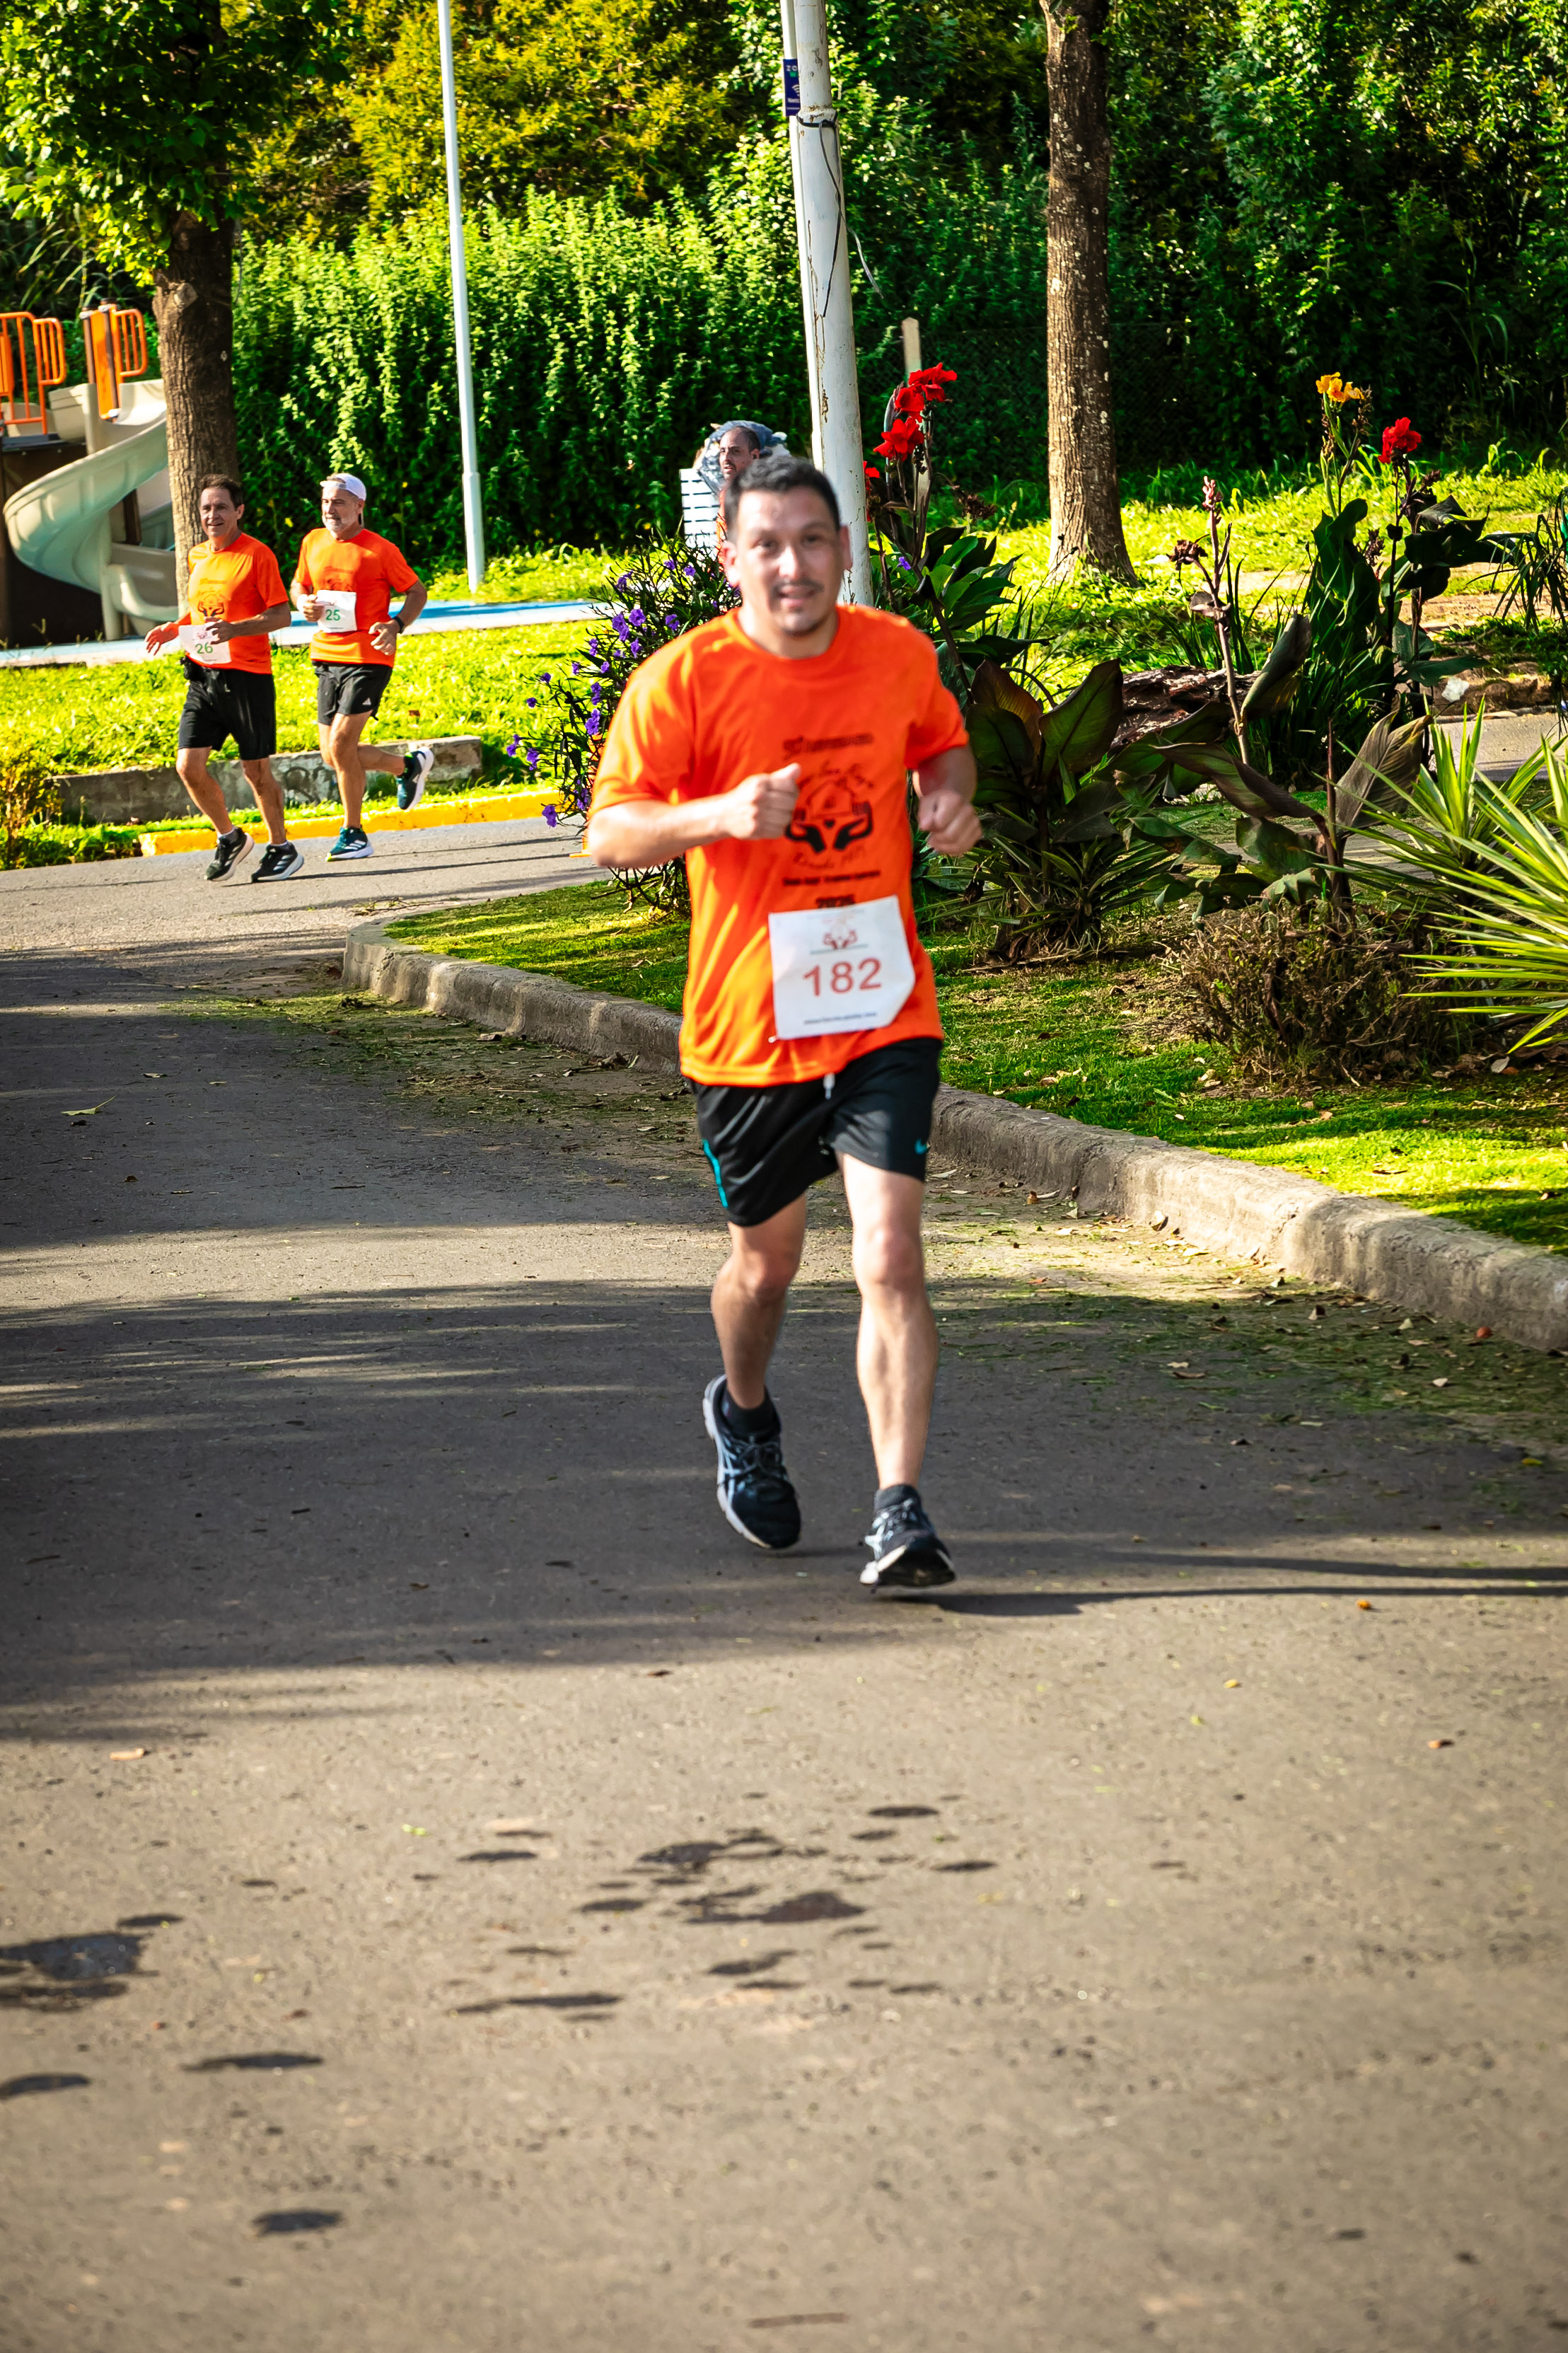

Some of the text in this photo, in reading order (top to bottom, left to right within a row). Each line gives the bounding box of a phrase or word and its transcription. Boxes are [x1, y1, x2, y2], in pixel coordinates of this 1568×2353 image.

[325, 609, 340, 621] 25
[195, 642, 213, 654] 26
[803, 957, 882, 997] 182
